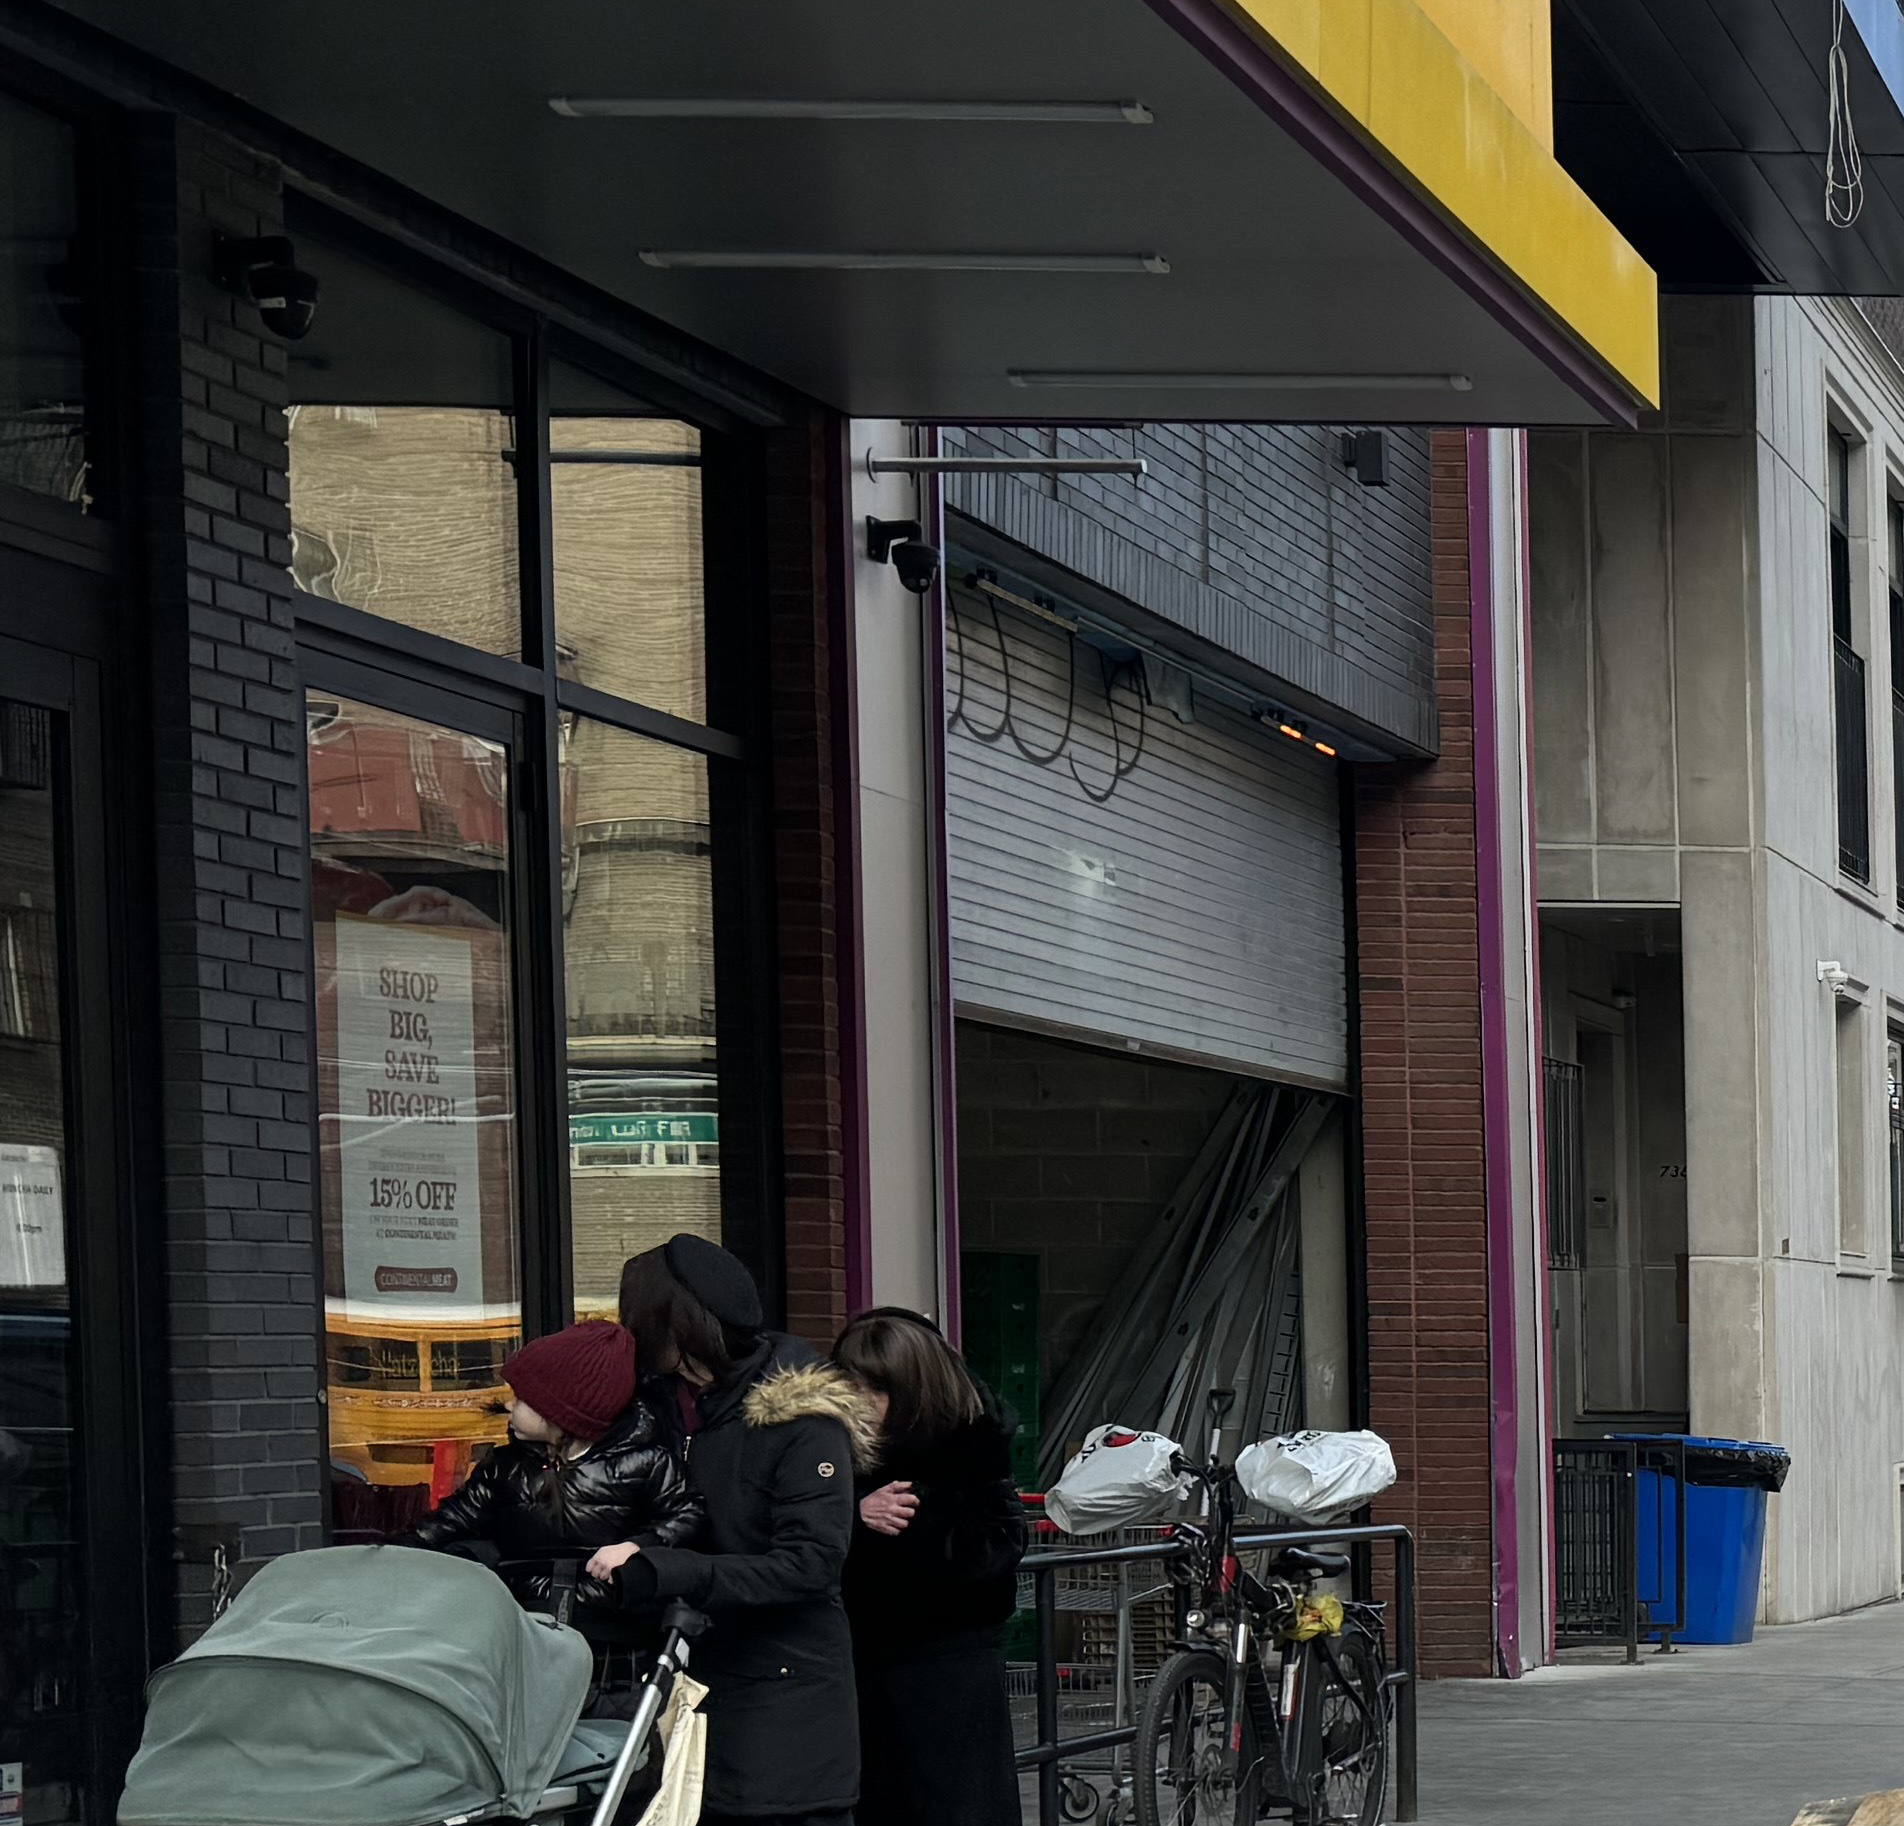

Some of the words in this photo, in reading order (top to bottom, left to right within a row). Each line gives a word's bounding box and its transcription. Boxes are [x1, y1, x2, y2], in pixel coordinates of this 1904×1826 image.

[379, 967, 438, 1003] SHOP
[389, 1009, 433, 1049] BIG,
[385, 1050, 439, 1084] SAVE
[366, 1088, 456, 1125] BIGGER!
[370, 1177, 413, 1209] 15%
[416, 1180, 457, 1211] OFF
